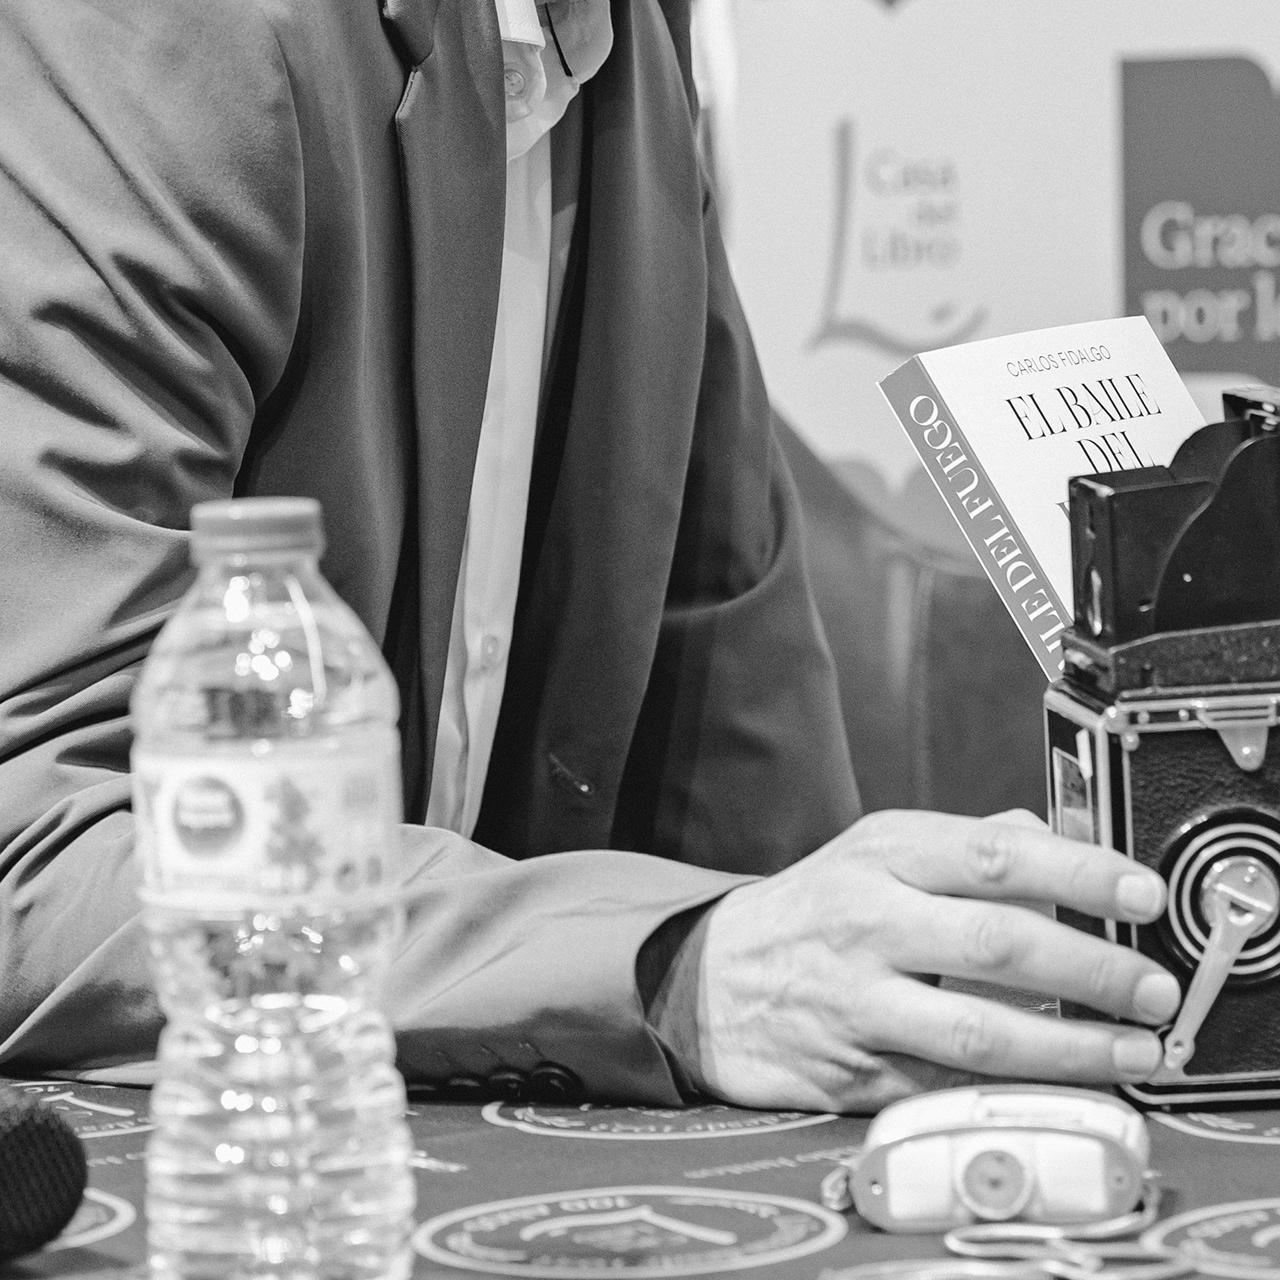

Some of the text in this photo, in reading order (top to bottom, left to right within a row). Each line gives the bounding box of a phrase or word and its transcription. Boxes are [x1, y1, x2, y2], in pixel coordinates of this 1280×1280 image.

[1139, 285, 1253, 343] por
[1006, 345, 1112, 377] CARLOS FIDALGO
[1005, 373, 1162, 441] EL BAILE
[909, 395, 994, 520] FUEGO
[1075, 431, 1156, 473] DEL
[983, 515, 1037, 594] DEL
